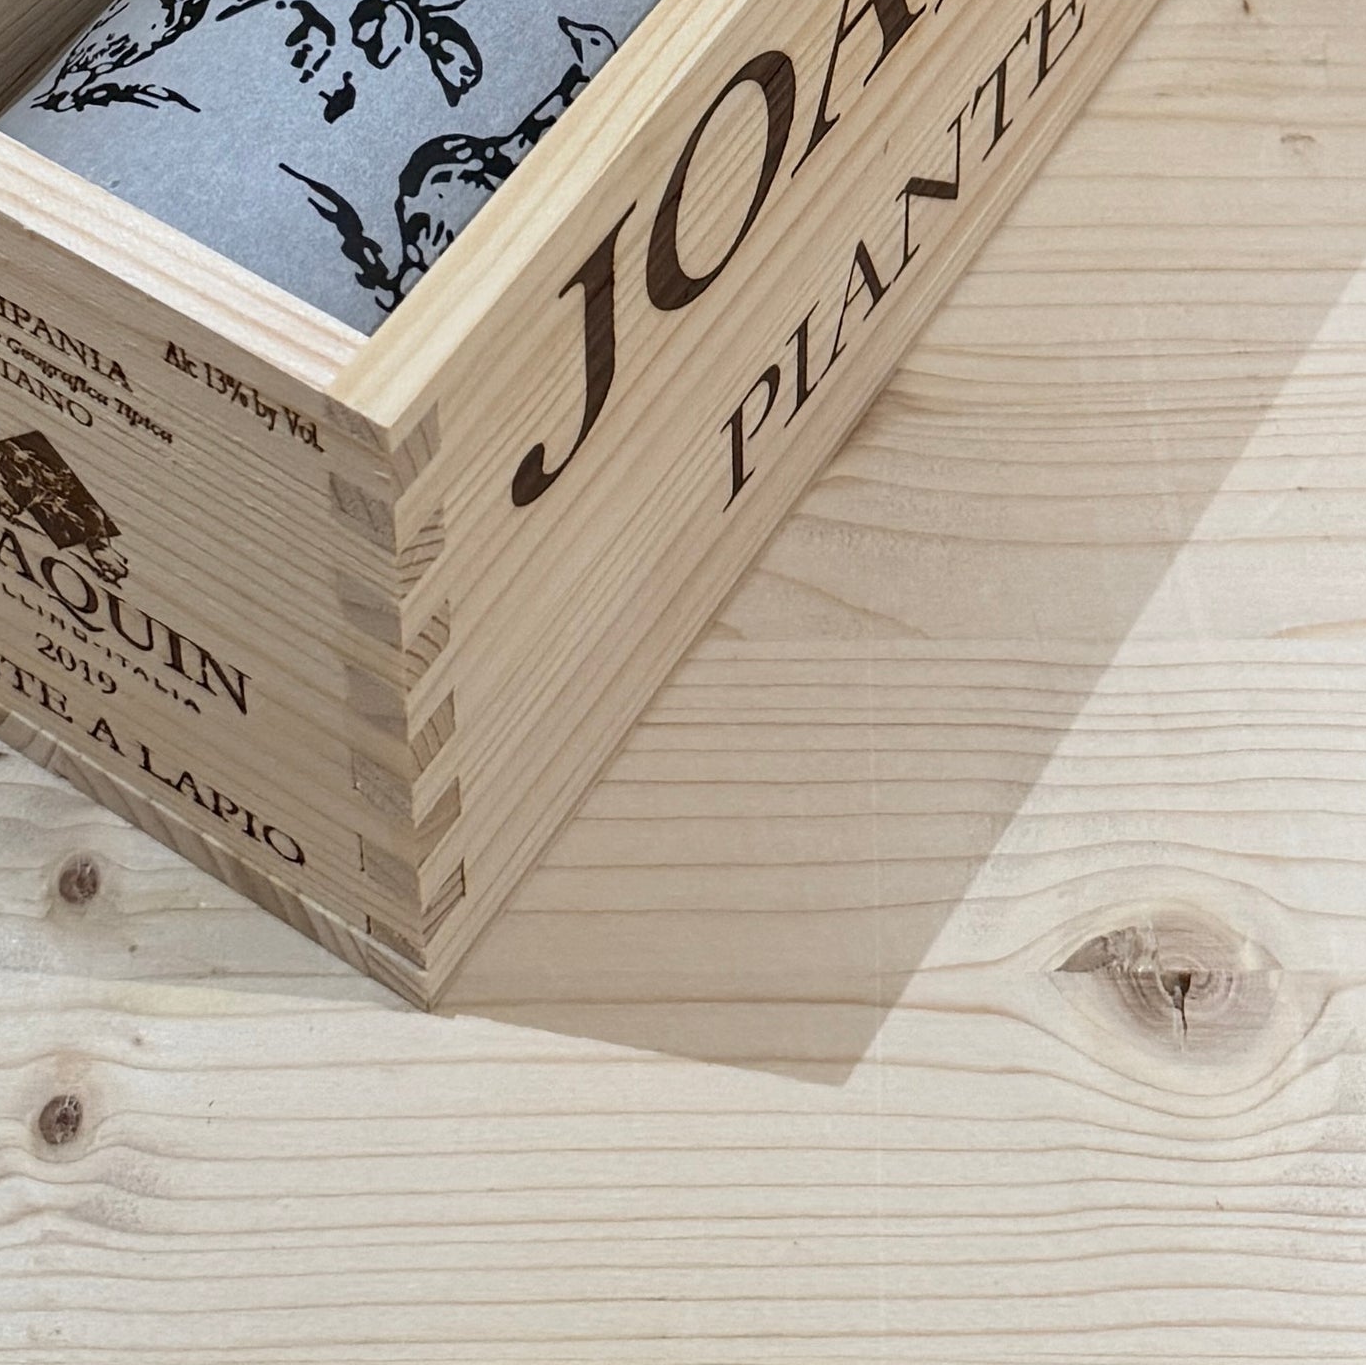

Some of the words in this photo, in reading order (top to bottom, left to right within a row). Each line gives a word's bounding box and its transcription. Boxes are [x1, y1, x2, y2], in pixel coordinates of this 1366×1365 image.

[6, 337, 109, 406] Geografica
[113, 397, 174, 445] Tipica
[202, 362, 249, 409] 13%
[251, 387, 279, 432] by
[36, 632, 118, 695] 2019
[87, 717, 126, 758] A
[135, 740, 307, 867] LAPIO
